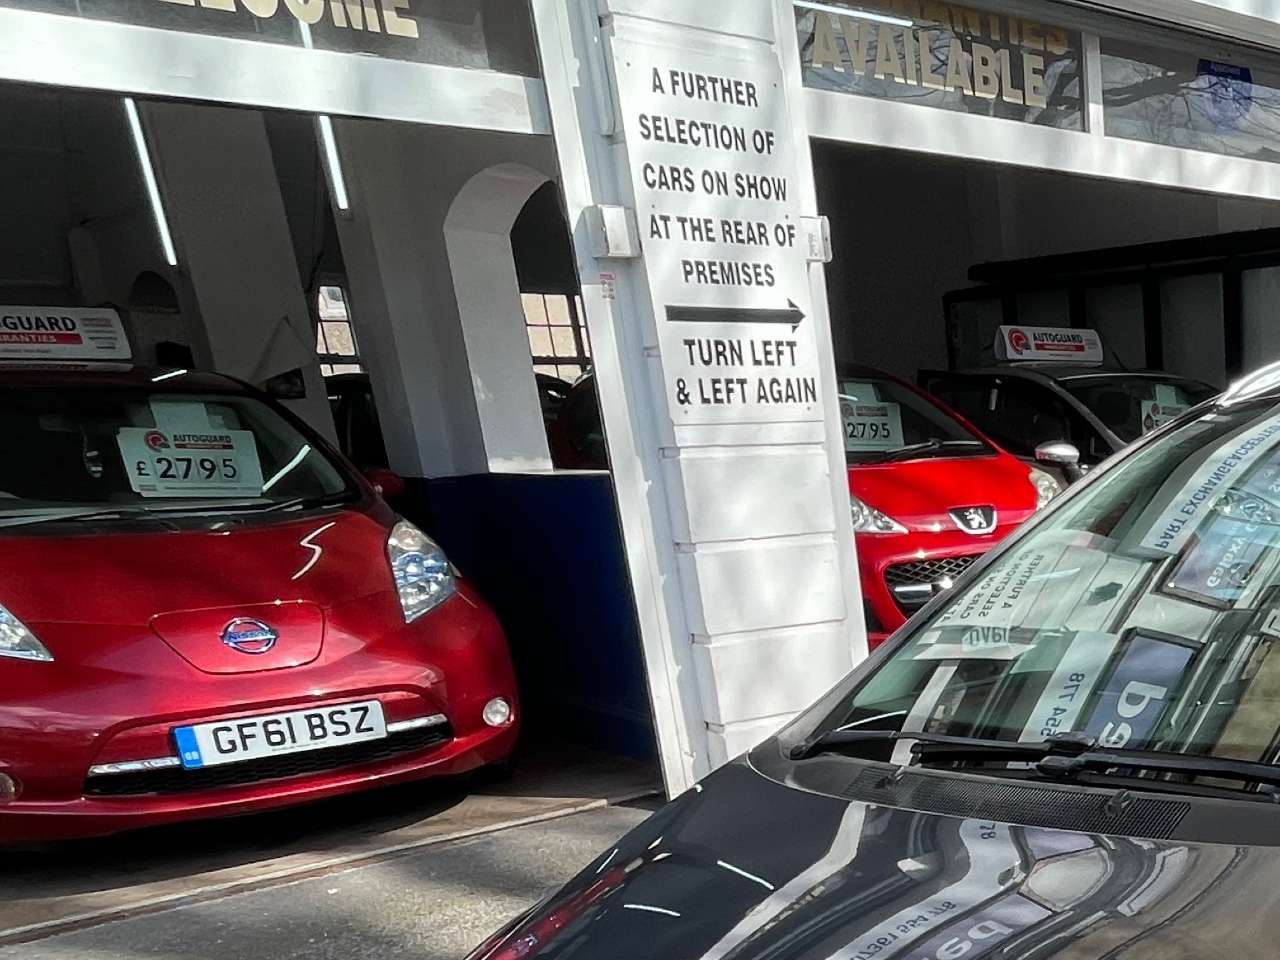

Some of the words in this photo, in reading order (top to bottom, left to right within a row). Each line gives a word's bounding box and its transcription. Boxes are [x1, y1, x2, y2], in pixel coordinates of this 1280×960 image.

[811, 11, 1047, 109] AVAILABLE
[652, 67, 665, 94] A
[669, 70, 759, 107] FURTHER
[639, 113, 747, 152] SELECTION
[753, 129, 774, 154] OF
[643, 162, 695, 193] CARS
[702, 169, 729, 195] ON
[734, 173, 786, 201] SHOW
[650, 214, 671, 239] AT
[676, 216, 716, 243] THE
[720, 219, 770, 246] REAR
[774, 224, 796, 247] OF
[682, 259, 775, 287] PREMISES
[1033, 332, 1083, 343] AUTOGUARD
[683, 339, 744, 366] TURN
[750, 340, 797, 366] LEFT
[676, 378, 692, 405] &
[698, 378, 747, 404] LEFT
[757, 378, 817, 403] AGAIN
[173, 433, 232, 444] AUTOGUARD
[846, 422, 891, 439] 2795
[156, 457, 237, 480] 2795
[212, 718, 297, 755] GF61
[304, 706, 375, 742] BSZ
